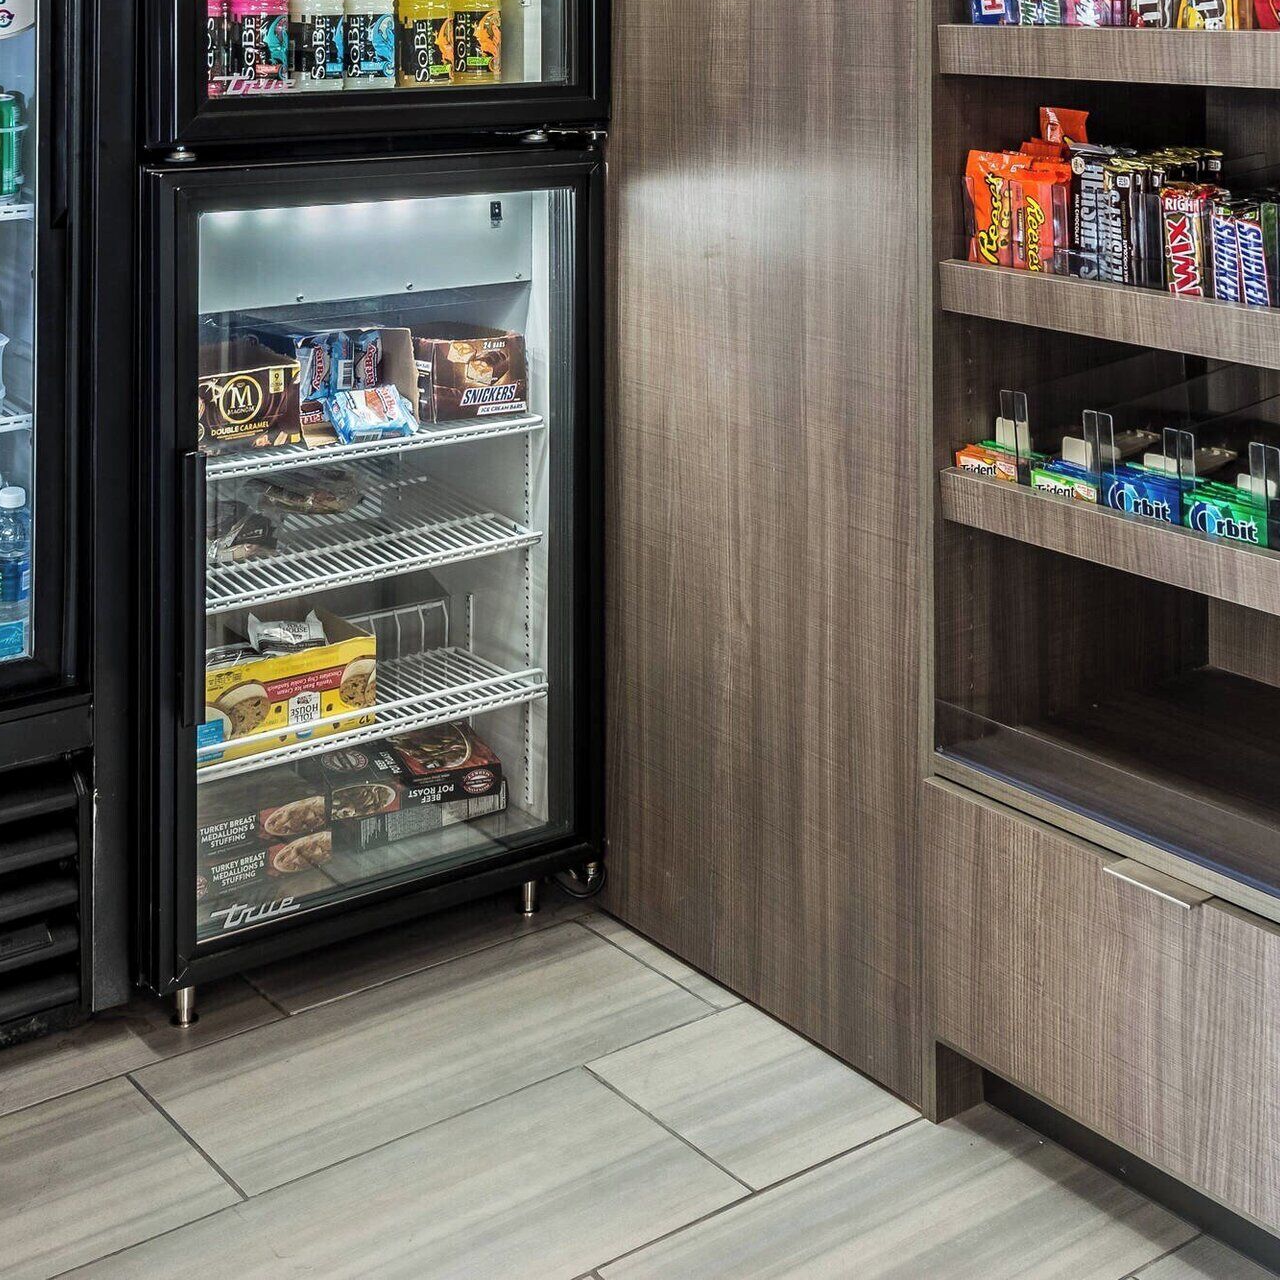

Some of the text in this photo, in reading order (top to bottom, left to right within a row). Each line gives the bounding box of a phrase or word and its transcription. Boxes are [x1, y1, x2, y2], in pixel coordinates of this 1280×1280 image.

[229, 385, 255, 409] M
[462, 384, 517, 405] SNICKERS
[490, 404, 509, 412] CREAM
[210, 420, 271, 438] DOUBLE CARAMEL
[1107, 480, 1172, 523] Orbit
[1188, 500, 1260, 544] Orbit
[266, 670, 342, 691] Chocolate Sandwich
[290, 702, 319, 717] HOUSE
[294, 712, 315, 723] TOLL
[408, 783, 455, 798] POT ROAST
[421, 794, 442, 804] BEEF
[200, 814, 257, 836] TURKEY BREAST
[201, 824, 249, 844] MEDALLIONS
[210, 832, 247, 848] STUFFING
[211, 851, 267, 875] TURKEY BREAST
[212, 862, 258, 882] MEDALLIONS
[221, 870, 257, 887] STUFFING
[210, 895, 302, 930] true
